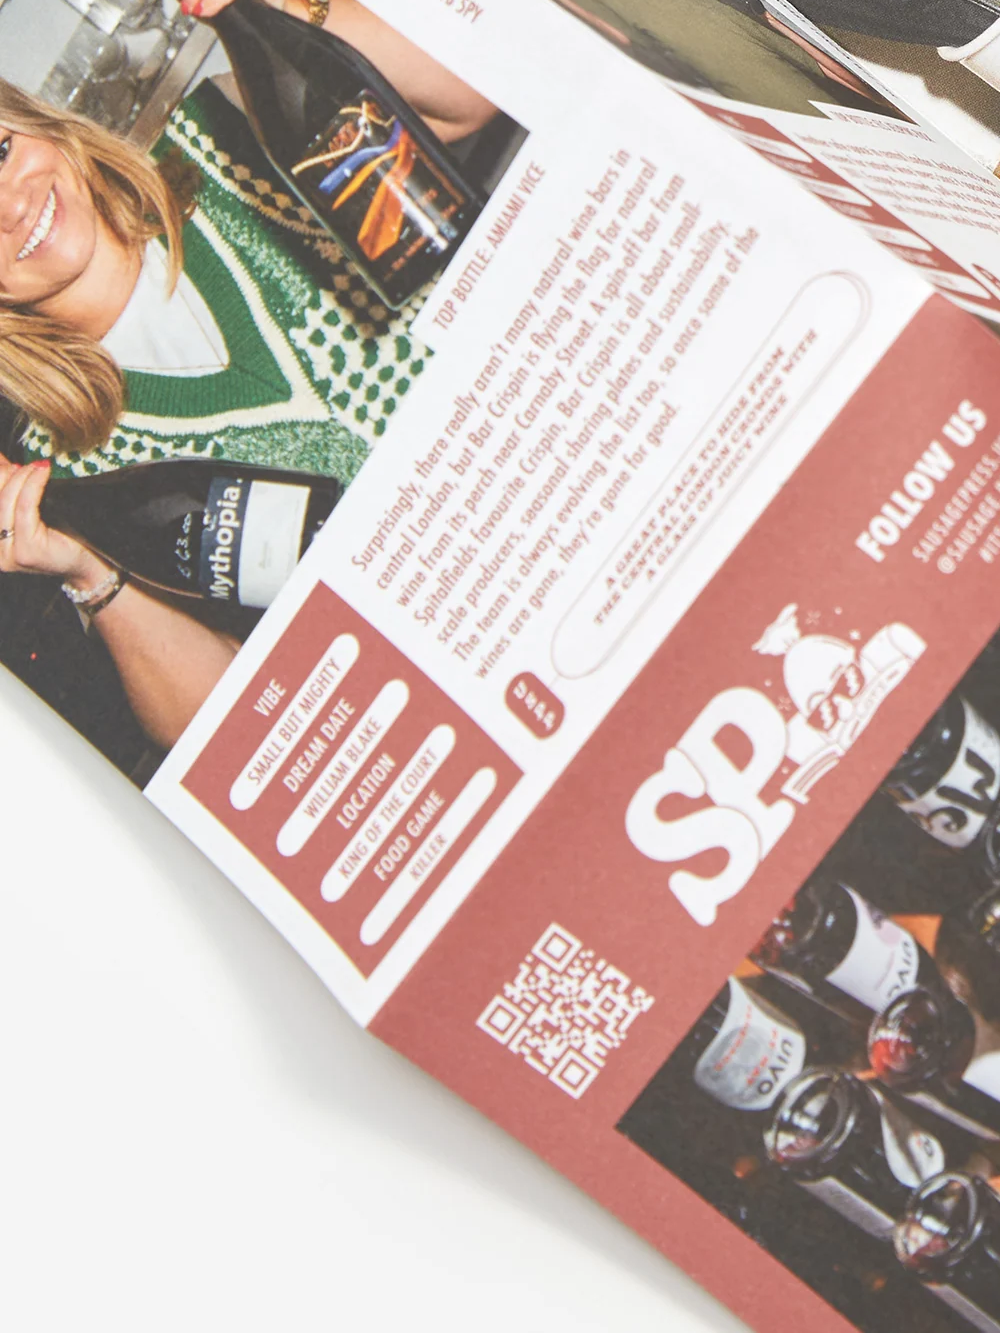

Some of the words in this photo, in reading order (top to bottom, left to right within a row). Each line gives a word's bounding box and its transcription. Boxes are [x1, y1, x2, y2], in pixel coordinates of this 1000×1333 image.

[586, 166, 620, 203] bars
[609, 148, 631, 168] in
[570, 189, 604, 238] wine
[538, 230, 581, 293] natural
[508, 285, 548, 336] many
[479, 327, 519, 384] aren't
[448, 376, 489, 431] really
[414, 422, 459, 474] there
[855, 440, 955, 562] FOLLOW
[941, 399, 986, 447] US
[246, 740, 285, 785] SMALL
[277, 709, 304, 742] BUT
[297, 656, 341, 715] MIGHTY
[252, 677, 287, 717] VIBE
[282, 735, 329, 793] DREAM
[319, 696, 356, 741] DATE
[302, 759, 351, 818] WILLIAM
[344, 716, 382, 763] BLAKE
[335, 752, 396, 829] LOCATION
[364, 819, 382, 843] OF
[378, 793, 404, 822] THE
[400, 746, 437, 795] COURT
[372, 833, 411, 881] FOOD
[405, 788, 445, 837] GAME
[409, 832, 447, 880] KILLER
